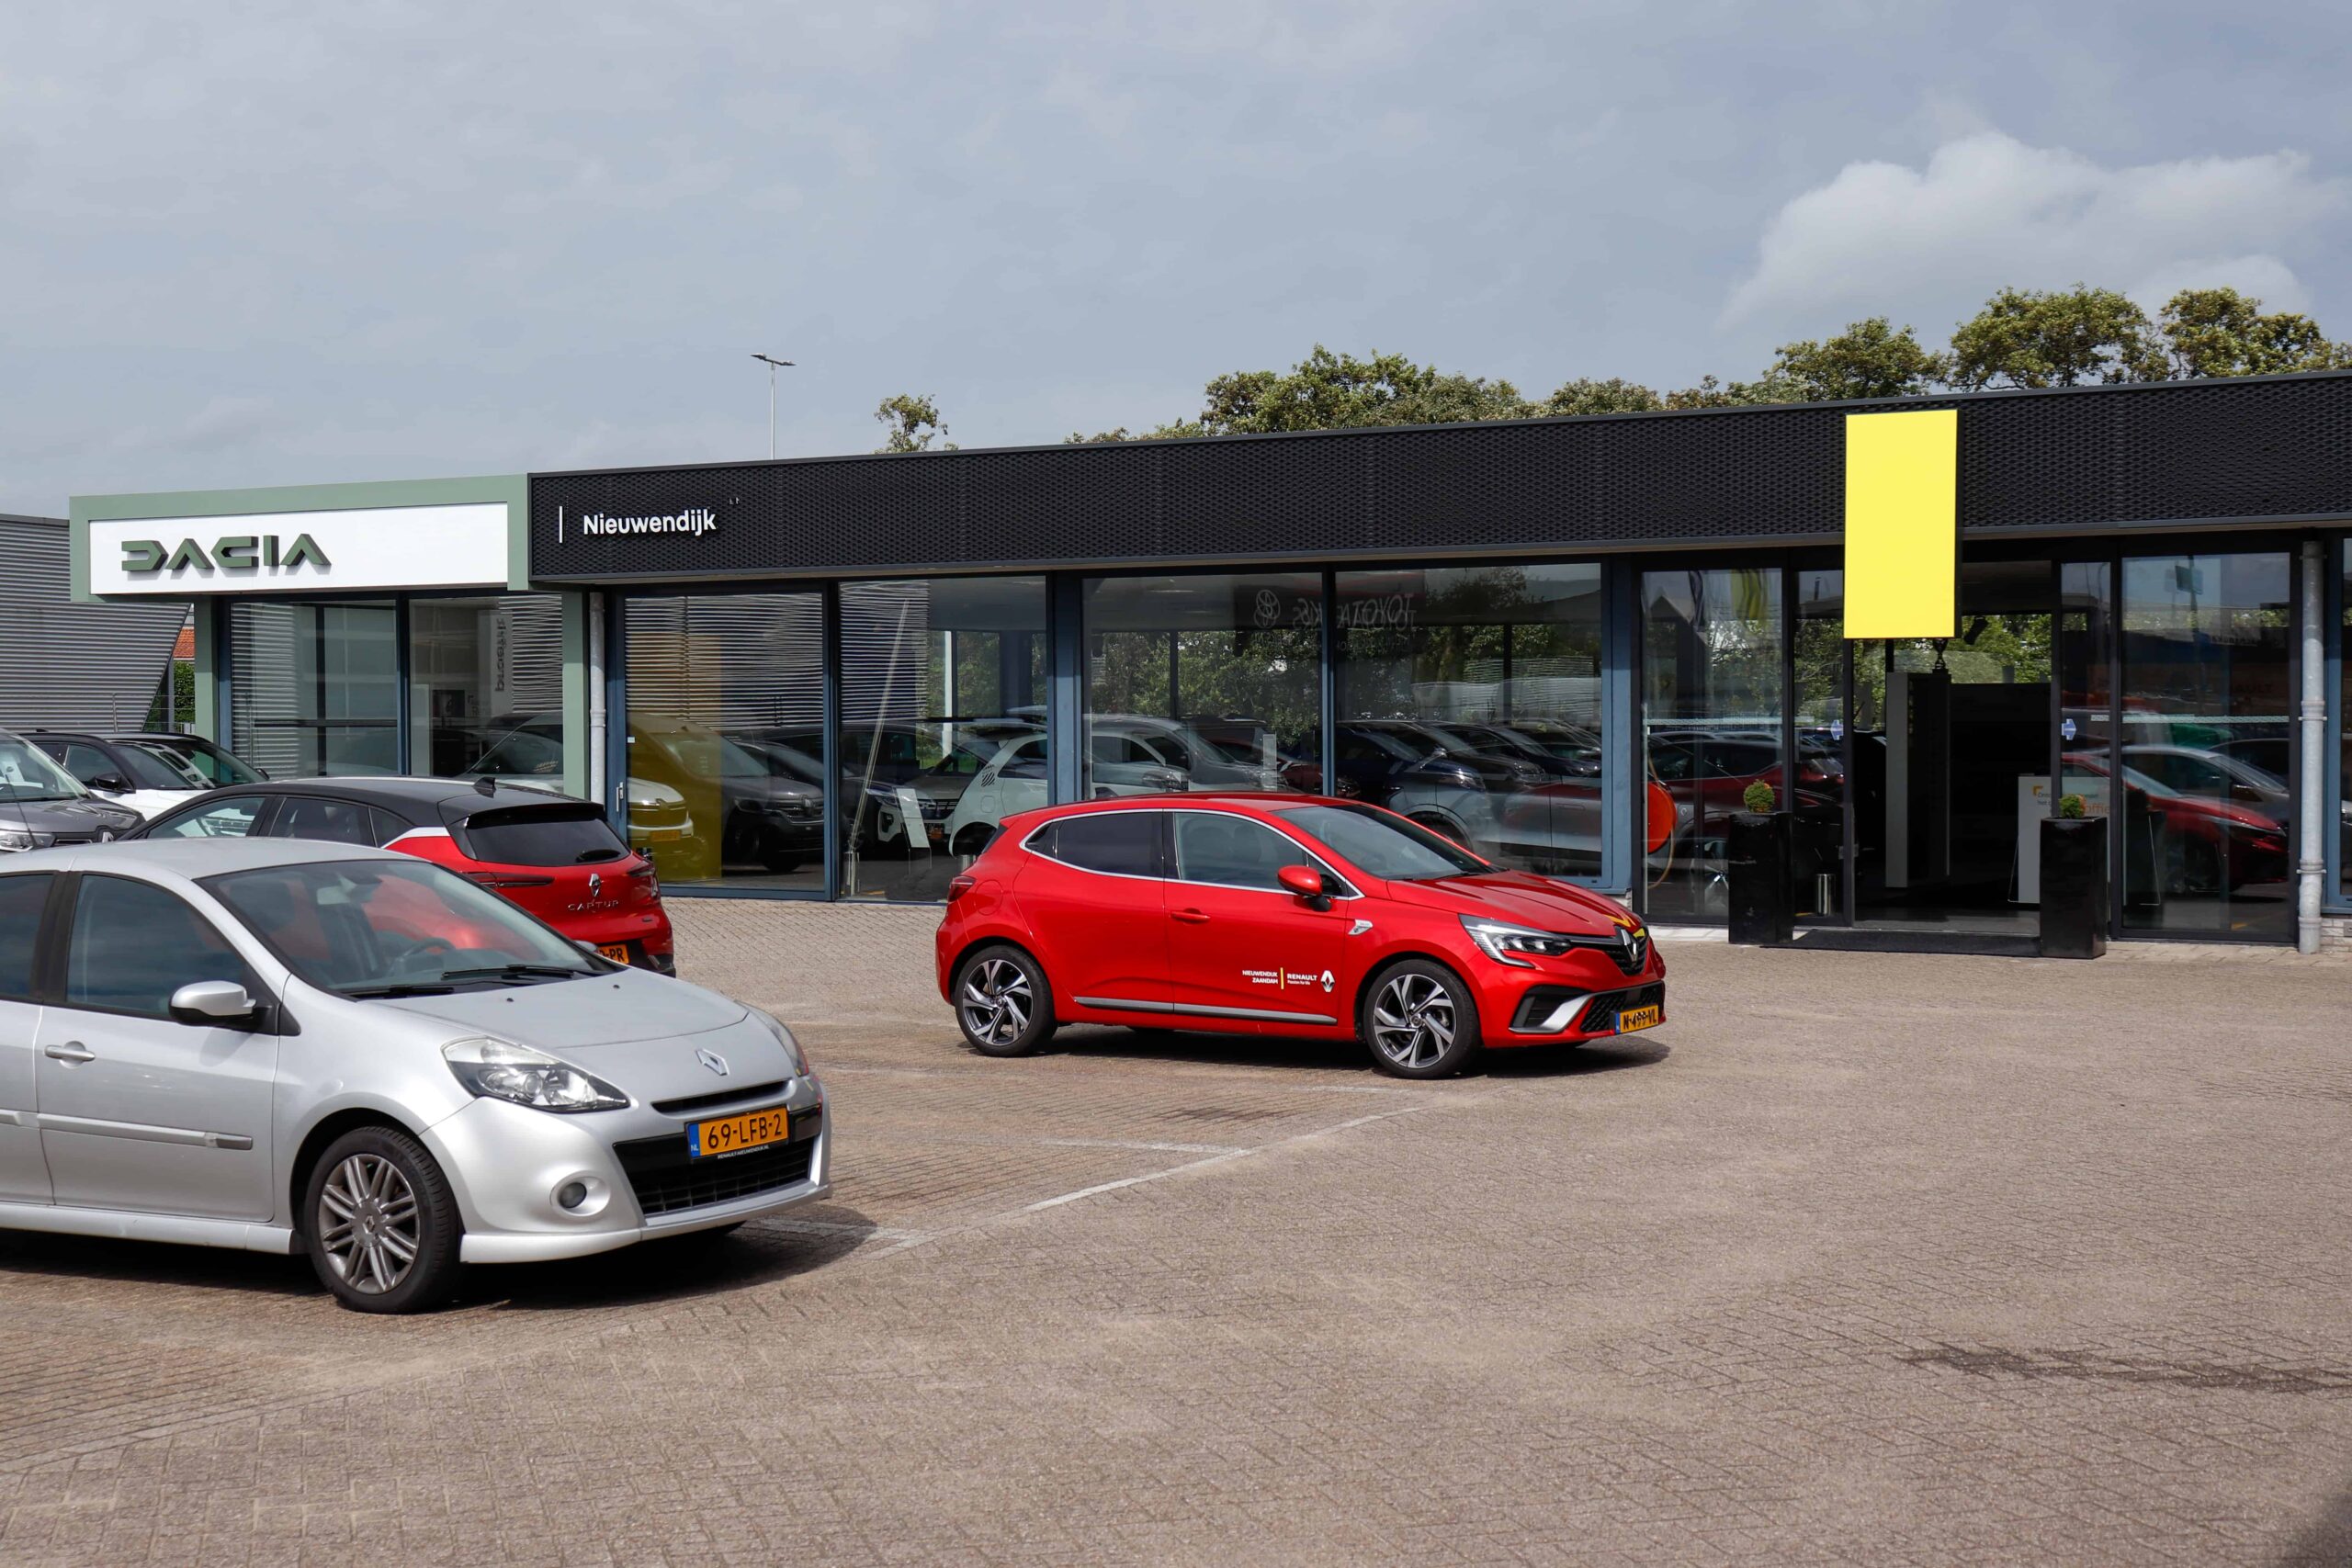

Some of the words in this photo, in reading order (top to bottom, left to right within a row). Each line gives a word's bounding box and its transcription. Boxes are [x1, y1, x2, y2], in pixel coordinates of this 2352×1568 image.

[583, 508, 717, 536] Nieuwendijk
[121, 533, 332, 571] DACIA
[707, 1113, 782, 1149] 69-LFB-2
